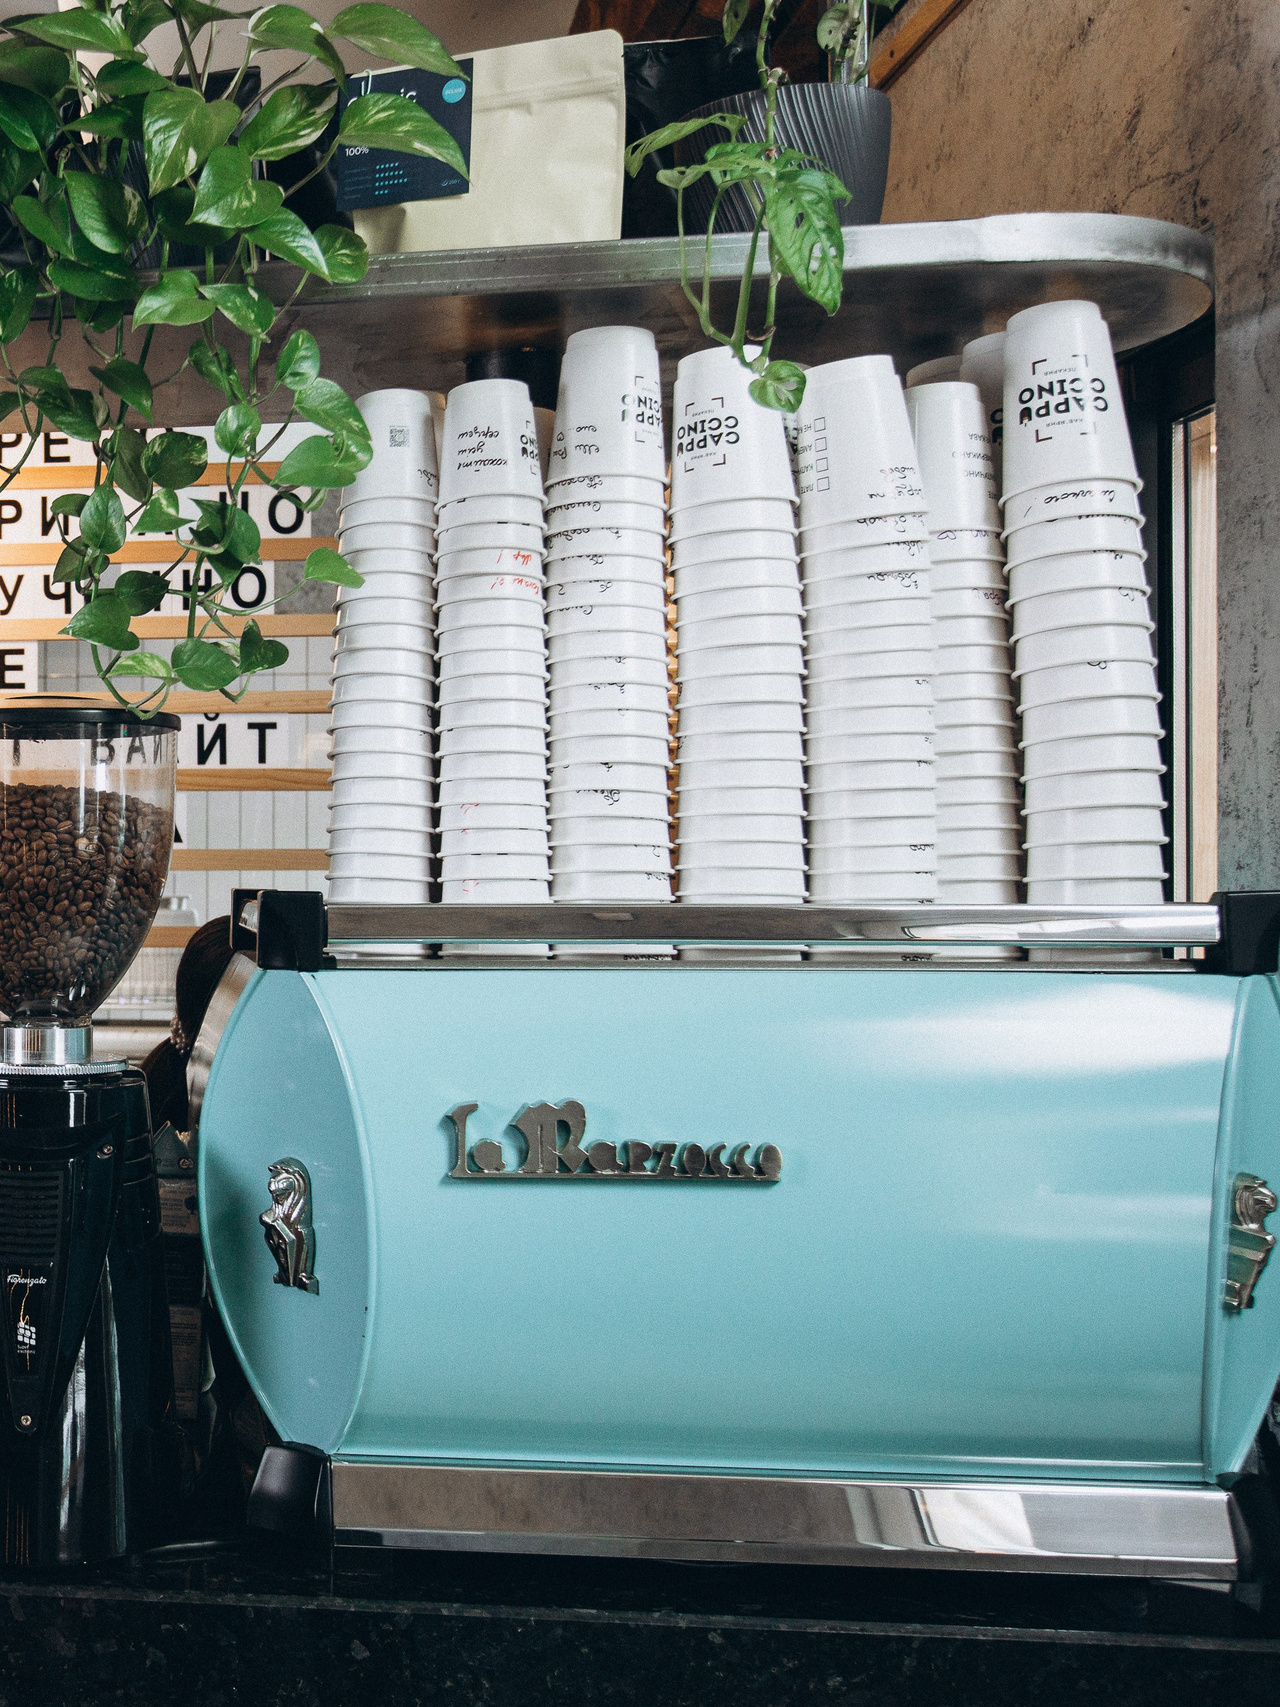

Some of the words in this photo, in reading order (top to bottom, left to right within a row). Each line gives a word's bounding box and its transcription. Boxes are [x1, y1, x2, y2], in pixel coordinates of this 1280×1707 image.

[345, 146, 369, 157] 100%
[1018, 377, 1106, 405] CCINO
[1019, 396, 1109, 427] CAPPU
[677, 415, 739, 440] CCINO
[677, 431, 740, 458] CAPPU
[445, 1098, 507, 1180] La
[508, 1097, 784, 1182] Marzocco
[7, 1274, 47, 1287] Fiorenzato
